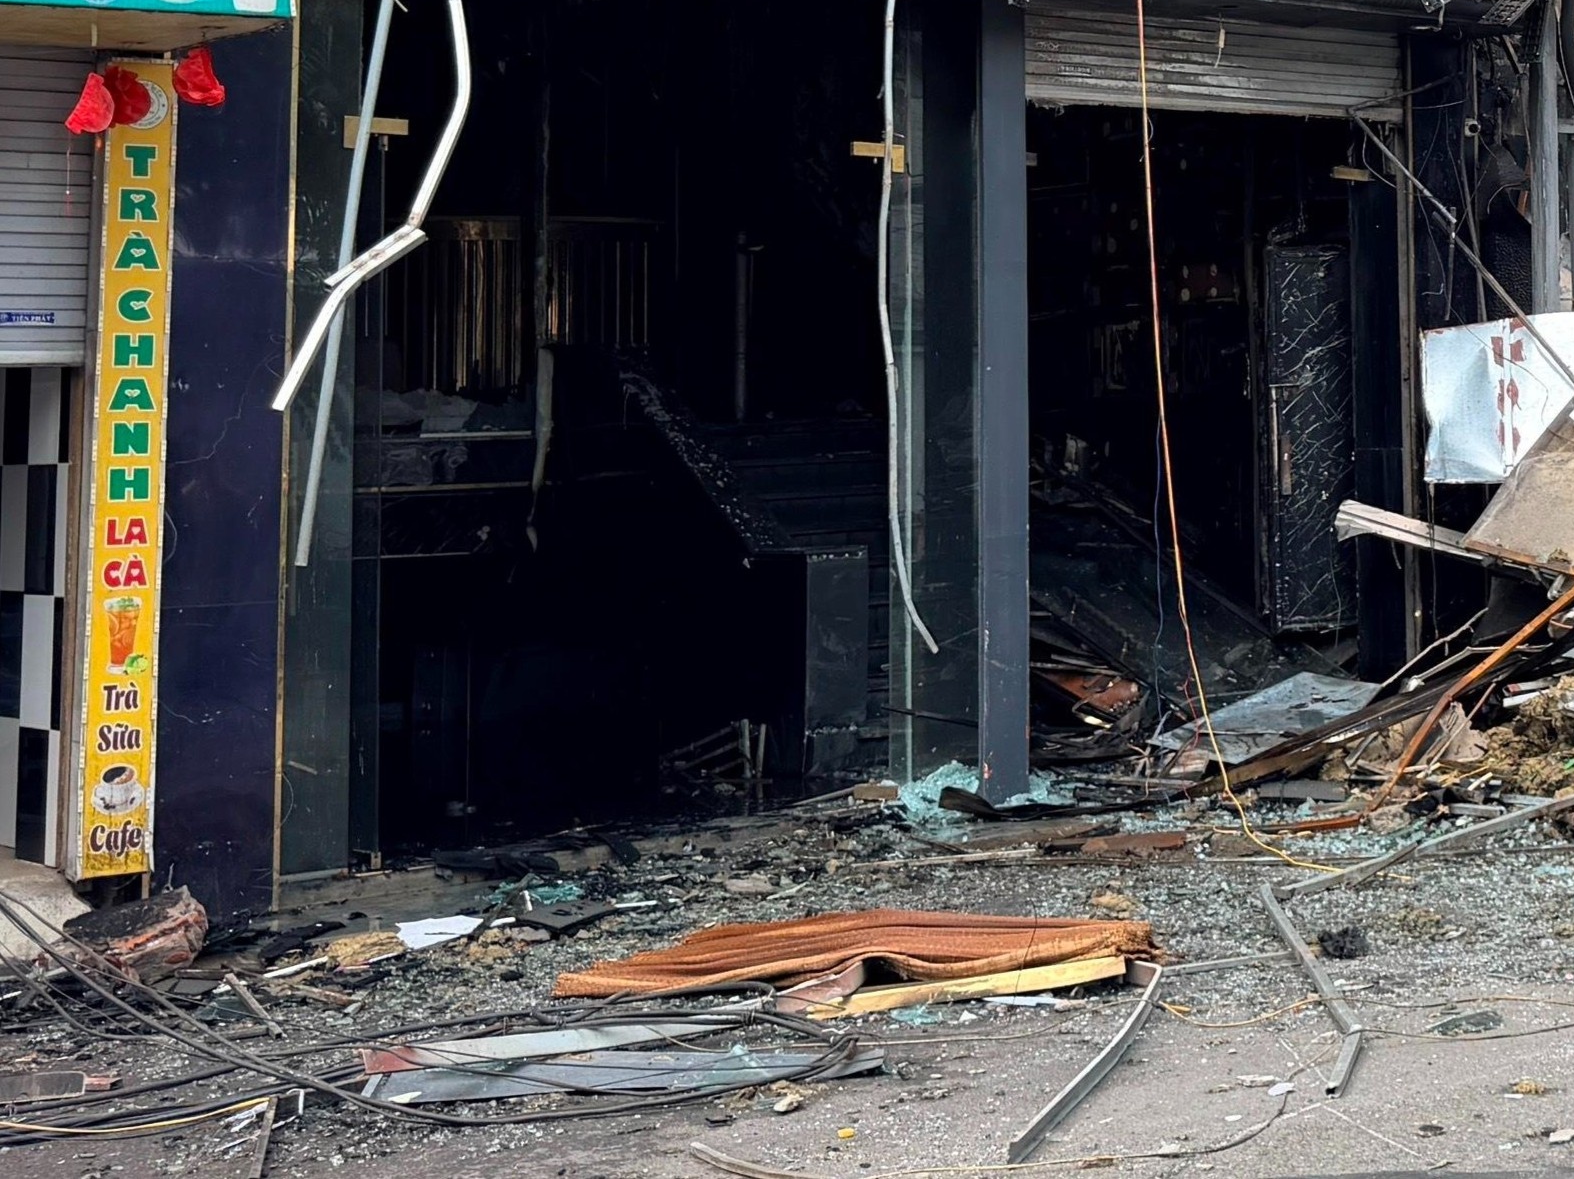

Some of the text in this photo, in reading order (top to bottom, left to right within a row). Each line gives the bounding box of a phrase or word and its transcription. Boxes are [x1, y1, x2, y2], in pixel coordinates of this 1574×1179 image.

[112, 144, 163, 272] TRÀ
[107, 288, 158, 502] CHANH
[105, 517, 149, 548] LA
[102, 554, 149, 590] CÀ
[102, 681, 140, 714] Trà
[97, 723, 142, 755] Sữa
[89, 819, 143, 858] Cafe
